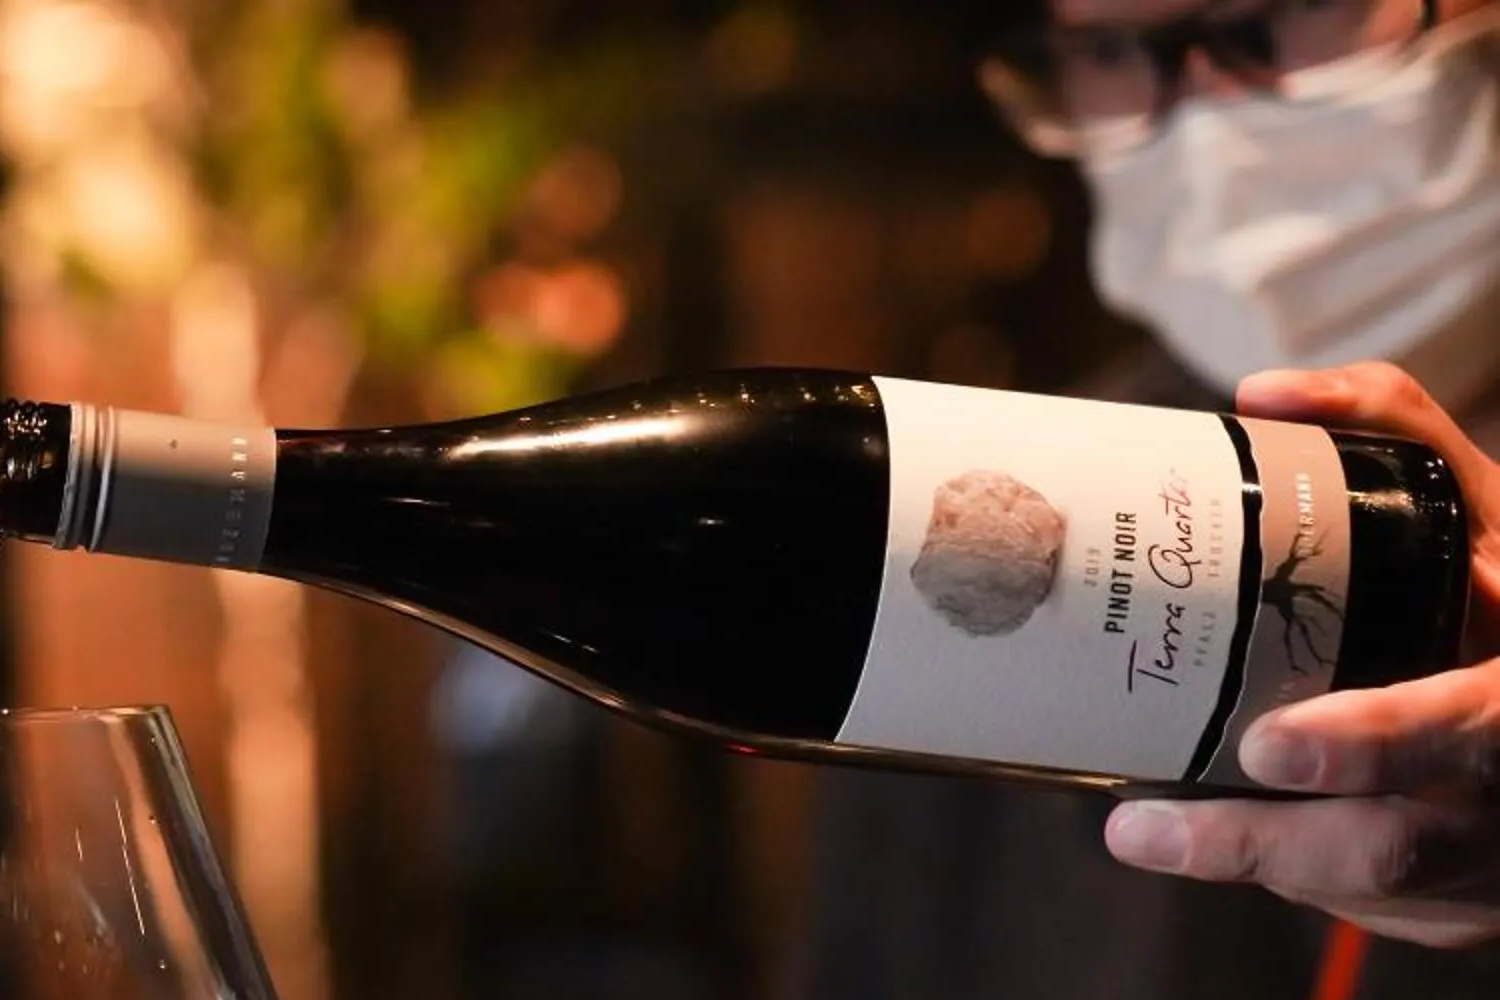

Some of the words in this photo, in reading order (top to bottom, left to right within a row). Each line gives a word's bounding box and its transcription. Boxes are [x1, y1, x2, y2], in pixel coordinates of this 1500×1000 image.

[1114, 511, 1137, 562] NOIR
[1104, 568, 1136, 635] PINOT
[1128, 602, 1187, 694] Terra
